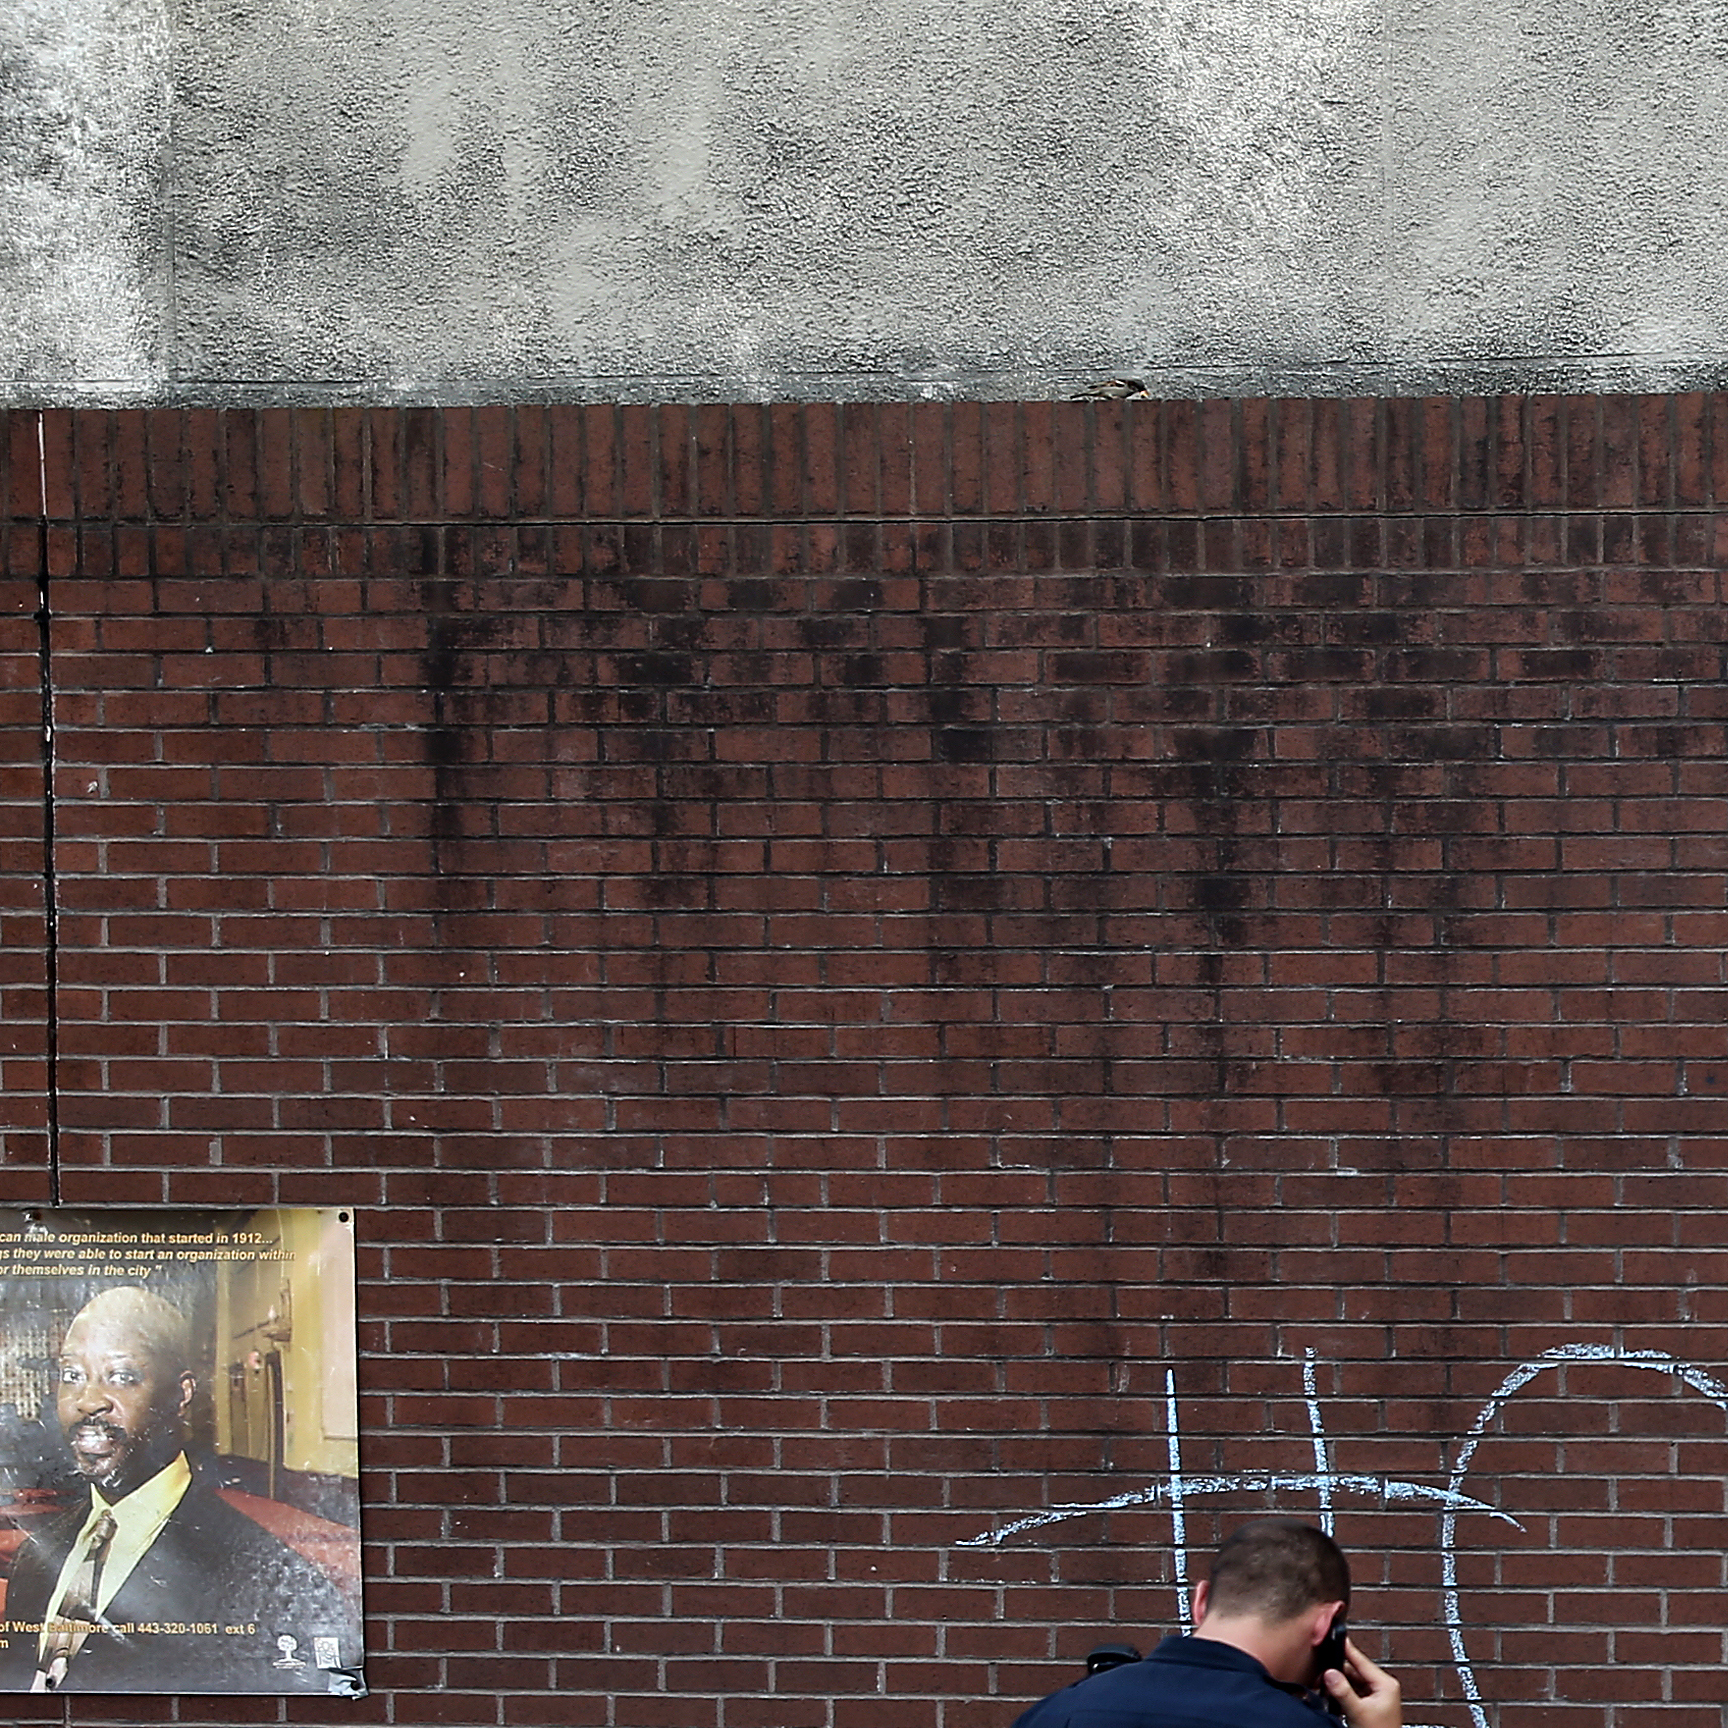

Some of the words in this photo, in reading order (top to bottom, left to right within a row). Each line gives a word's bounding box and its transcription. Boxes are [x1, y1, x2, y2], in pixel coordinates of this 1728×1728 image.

[24, 1232, 55, 1243] male
[58, 1232, 138, 1246] organization
[141, 1232, 166, 1243] that
[168, 1232, 214, 1243] started
[217, 1232, 229, 1243] in
[13, 1247, 41, 1262] they
[44, 1250, 76, 1260] were
[78, 1248, 106, 1260] able
[109, 1249, 122, 1260] to
[125, 1249, 155, 1260] start
[157, 1250, 174, 1260] an
[176, 1248, 256, 1263] organization
[258, 1248, 297, 1261] within
[12, 1264, 84, 1276] themselves
[88, 1264, 101, 1276] in
[104, 1264, 125, 1276] the
[127, 1264, 152, 1279] city
[47, 1622, 109, 1634] Baltimore
[225, 1624, 245, 1635] ext
[247, 1623, 256, 1635] 6
